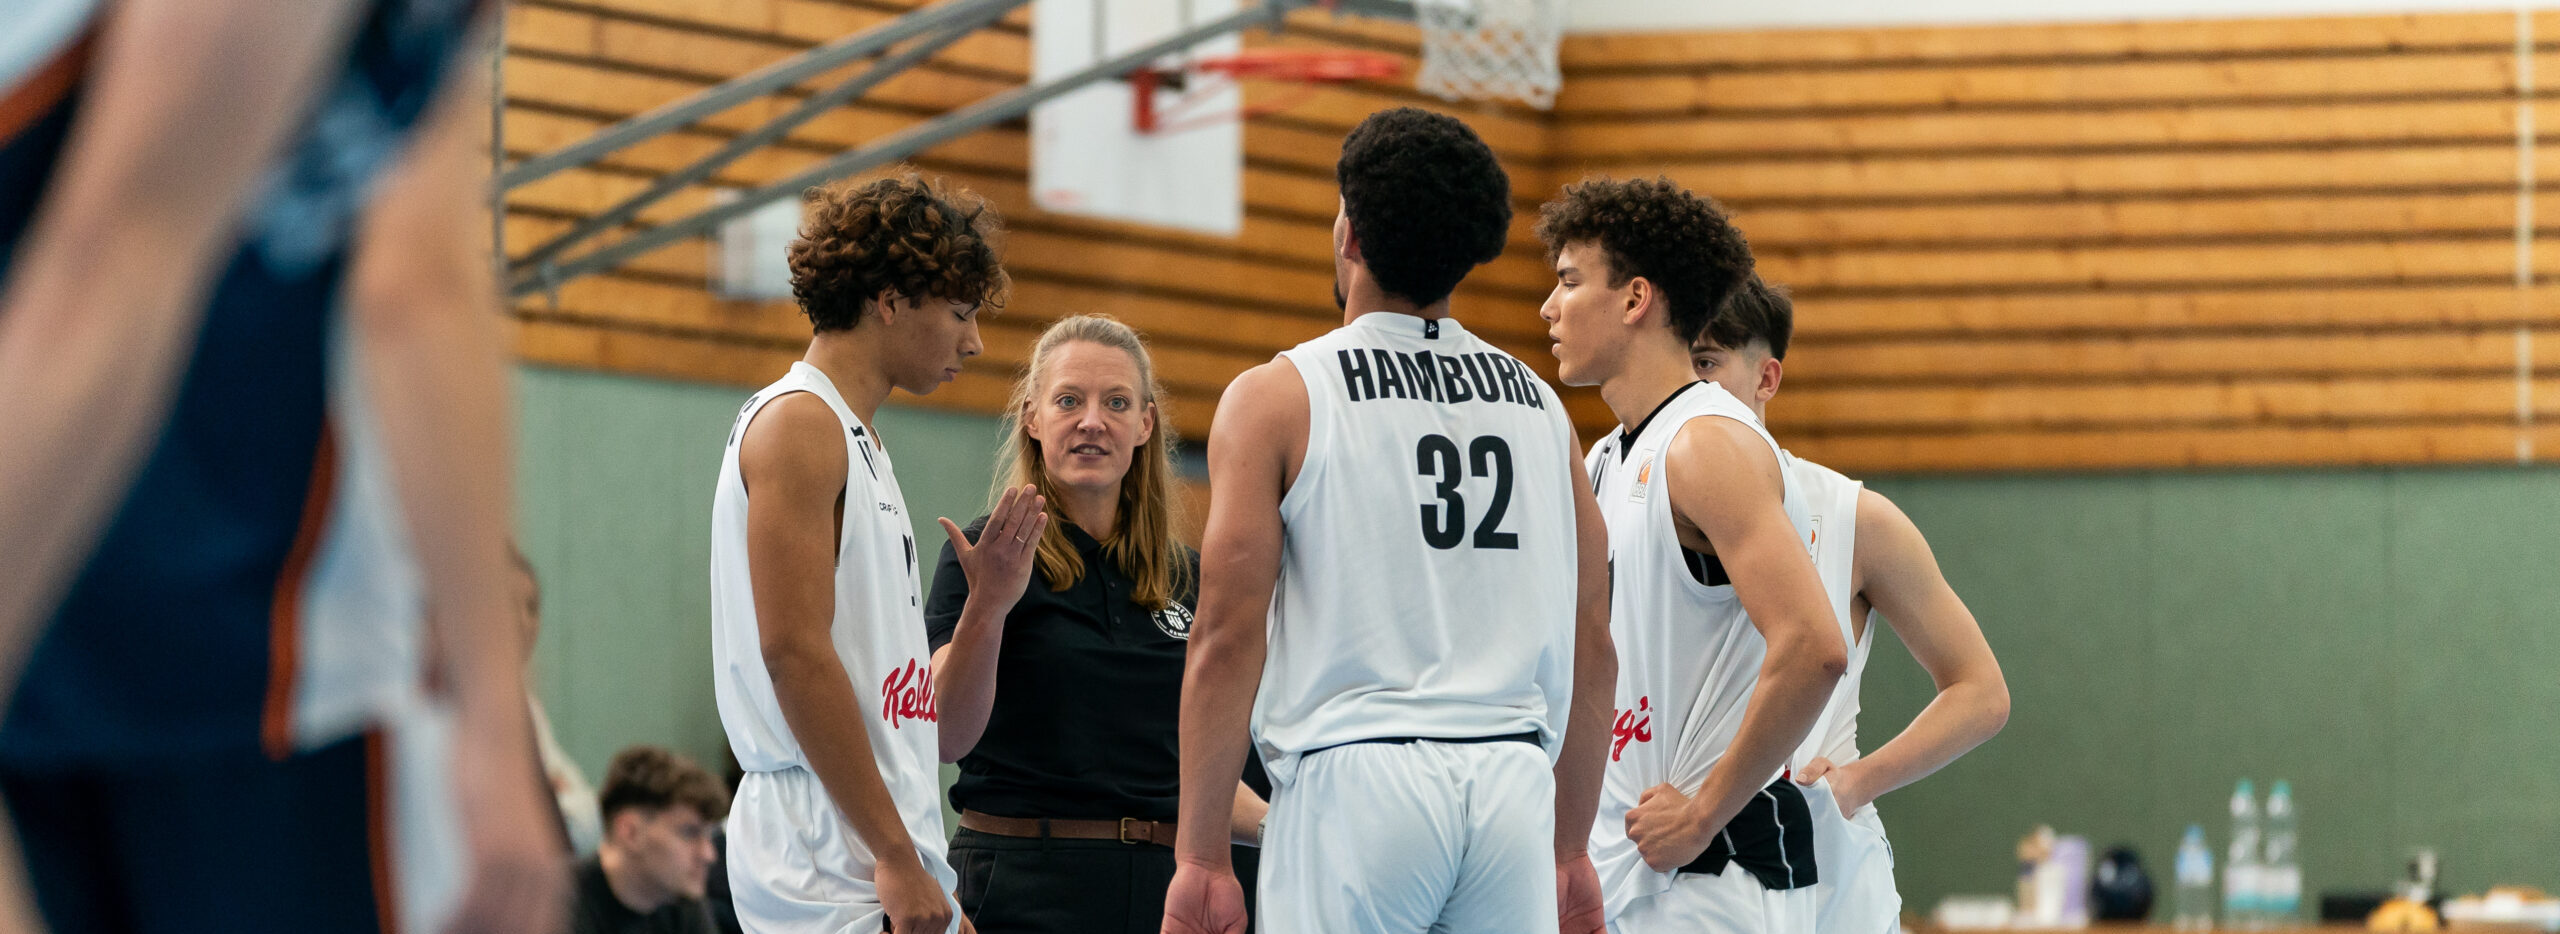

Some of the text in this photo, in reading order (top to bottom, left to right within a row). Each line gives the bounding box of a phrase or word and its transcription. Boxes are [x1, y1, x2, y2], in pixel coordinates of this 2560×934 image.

[1337, 348, 1545, 411] HAMBURG
[1416, 433, 1519, 550] 32
[1612, 695, 1652, 763] g's
